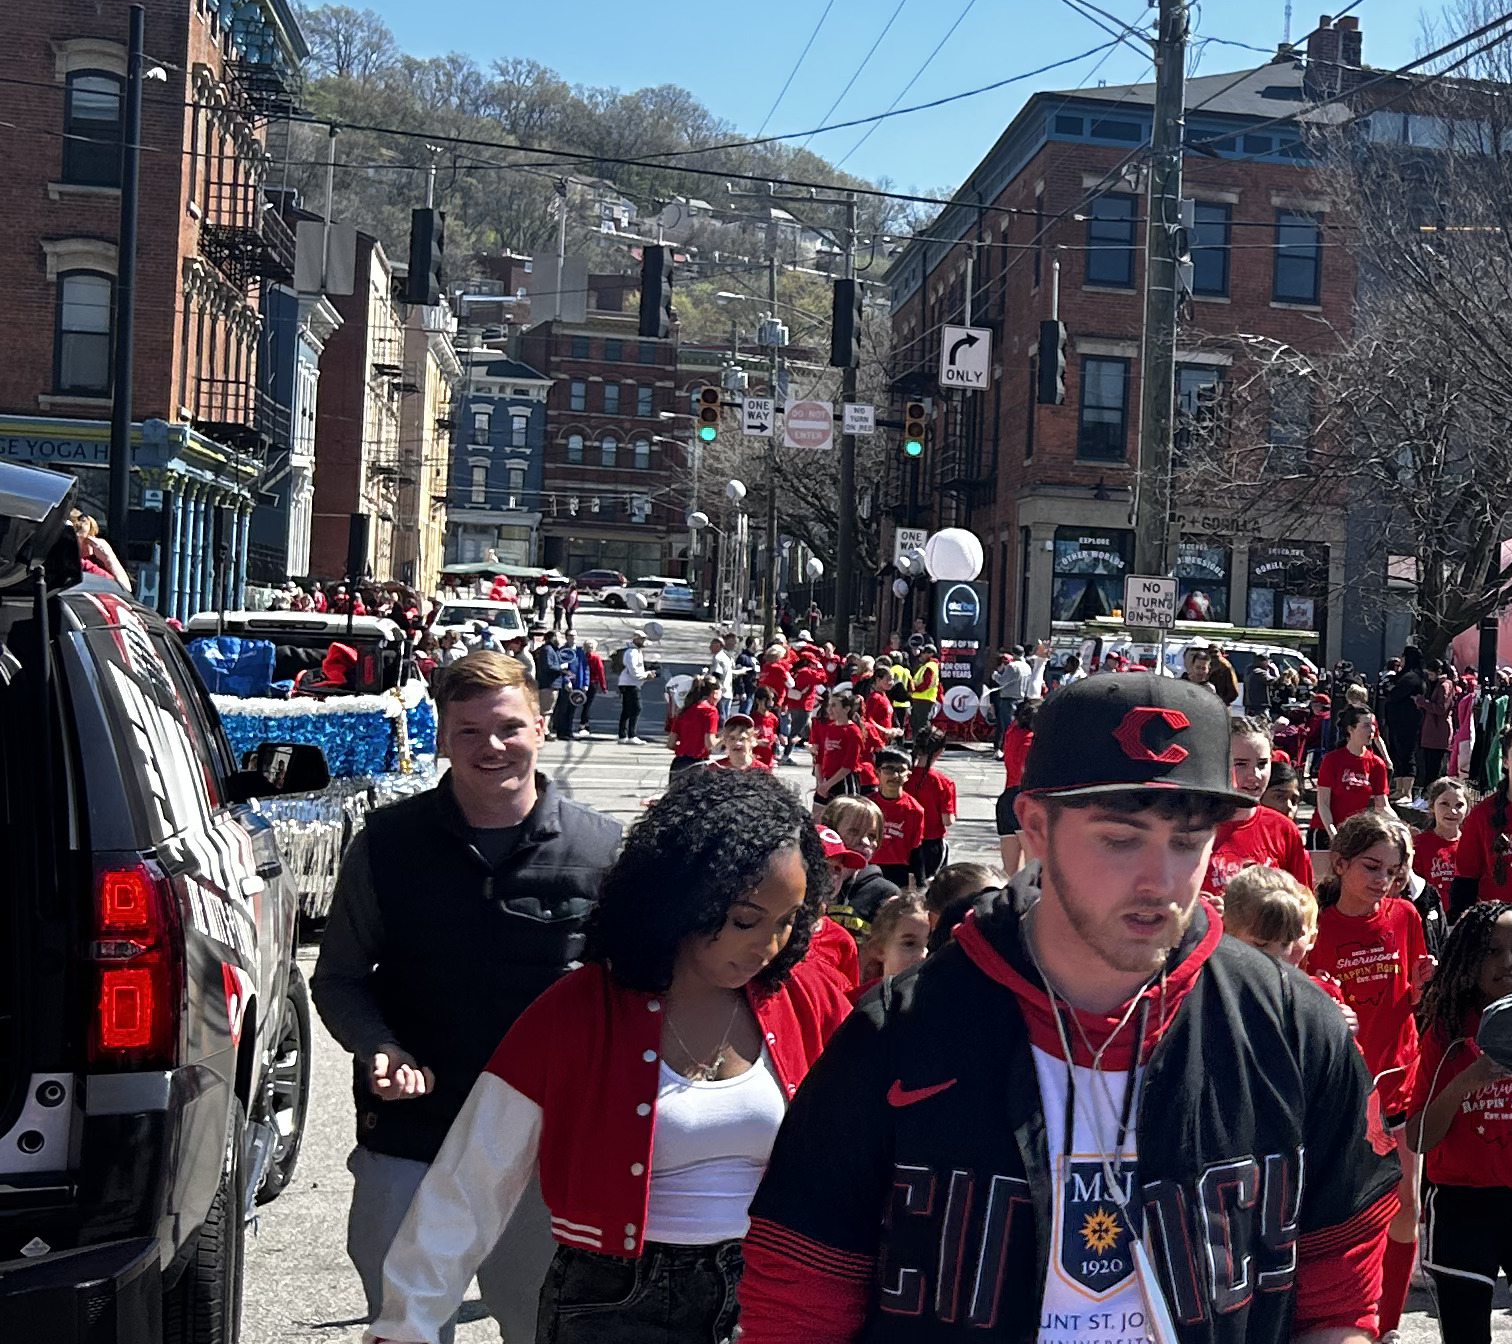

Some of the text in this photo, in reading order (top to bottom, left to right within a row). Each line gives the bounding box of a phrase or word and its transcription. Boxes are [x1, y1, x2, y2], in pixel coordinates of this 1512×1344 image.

[946, 369, 983, 383] ONLY
[748, 401, 770, 410] ONE
[748, 411, 770, 420] WAY
[808, 410, 826, 418] NOT
[795, 432, 823, 440] ENTER
[26, 440, 86, 459] YOGA
[95, 444, 141, 461] HT
[901, 531, 922, 541] ONE
[900, 542, 923, 550] WAY
[1061, 551, 1125, 569] OTHER WORLDS
[1143, 582, 1160, 593] NO
[1136, 597, 1166, 608] TURN
[1128, 611, 1172, 623] ON RED
[1112, 706, 1191, 765] C
[1081, 1258, 1124, 1277] 1920
[1041, 1313, 1083, 1331] UNT
[1089, 1313, 1115, 1330] ST.
